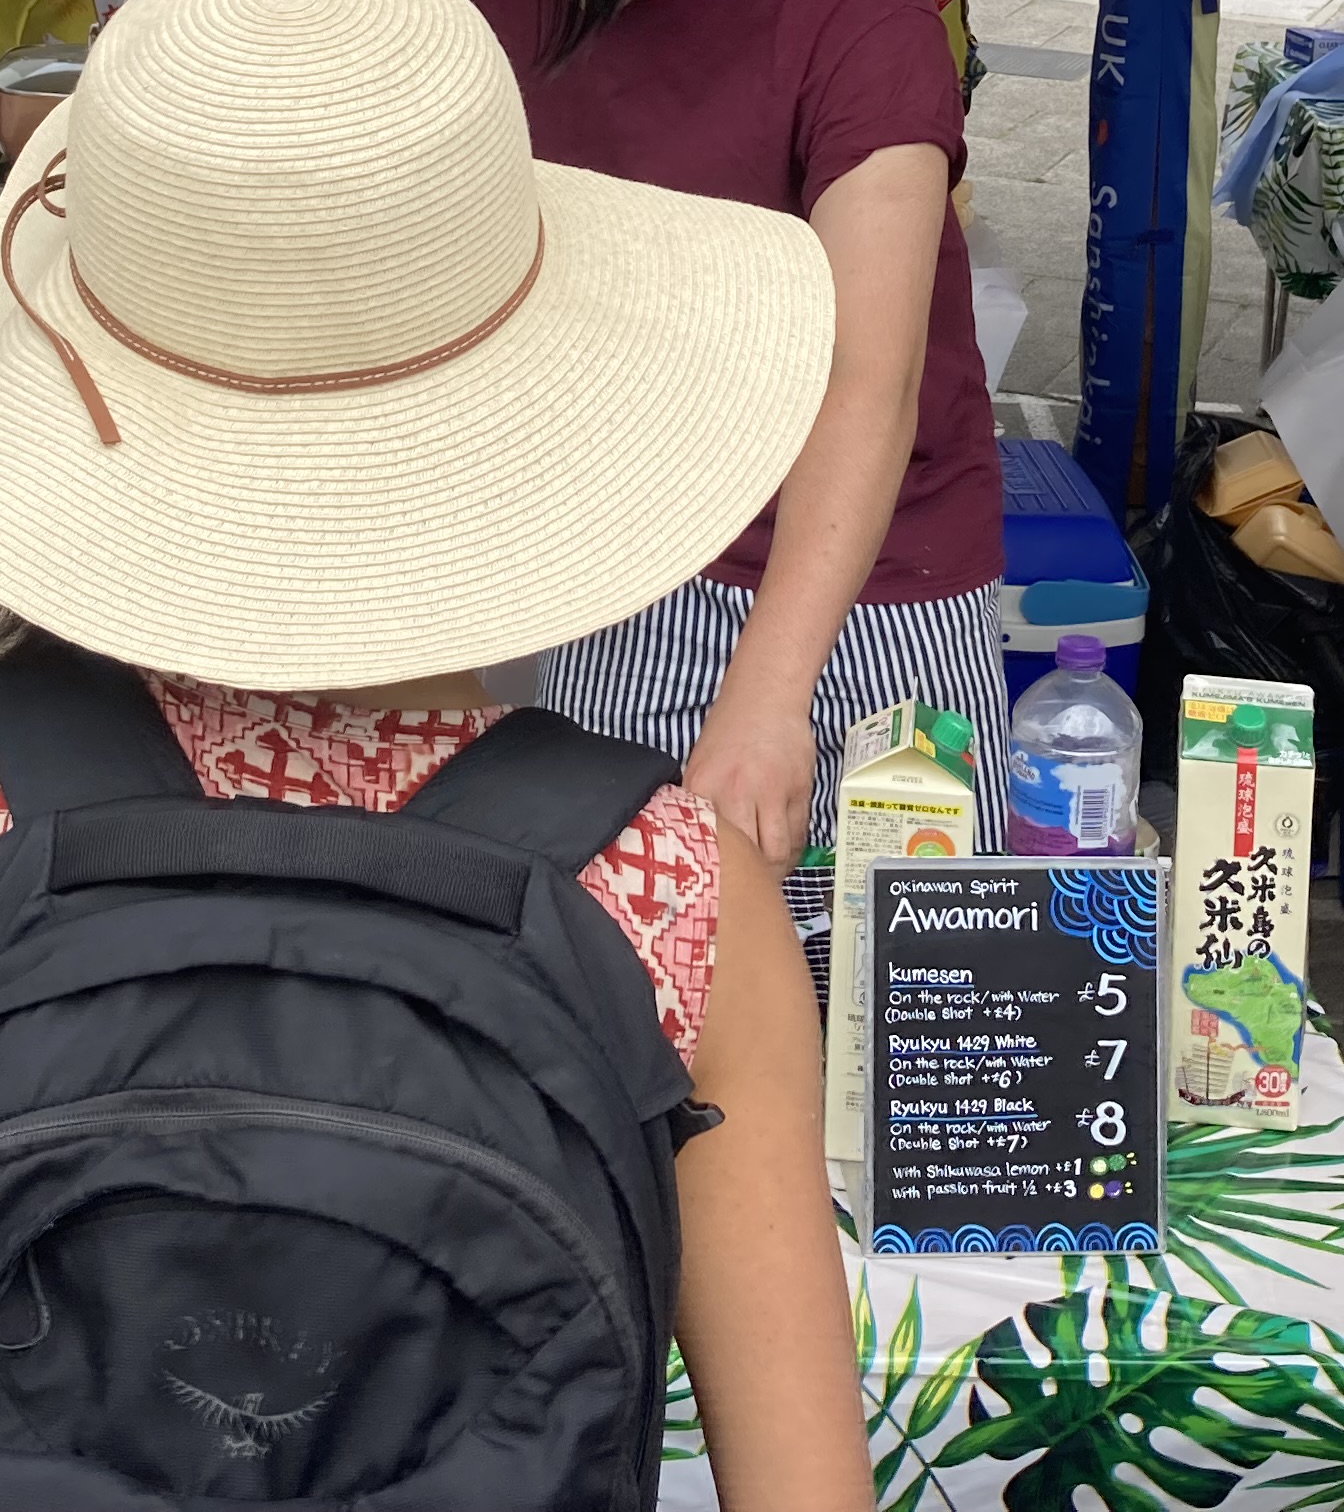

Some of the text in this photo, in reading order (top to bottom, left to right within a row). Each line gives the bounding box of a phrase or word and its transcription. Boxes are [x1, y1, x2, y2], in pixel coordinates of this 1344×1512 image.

[1097, 15, 1129, 86] UK
[1237, 771, 1255, 835] 琉球泡盛
[970, 878, 1019, 899] Spirit
[1247, 845, 1278, 958] 久米島の
[888, 897, 1038, 933] Awamori
[1196, 858, 1245, 970] 久米仙
[889, 991, 911, 1005] On
[918, 990, 943, 1005] the
[1077, 973, 1127, 1016] £5
[889, 1034, 1128, 1080] Ryukyu 1429 White £7
[889, 1057, 911, 1070] On
[915, 1056, 940, 1070] the
[890, 1098, 1126, 1146] Ryukyu 1429 Black £8
[890, 1123, 911, 1135] On
[918, 1121, 940, 1135] the
[1006, 1160, 1049, 1175] lemon
[927, 1182, 979, 1199] passion
[982, 1179, 1017, 1195] fruit
